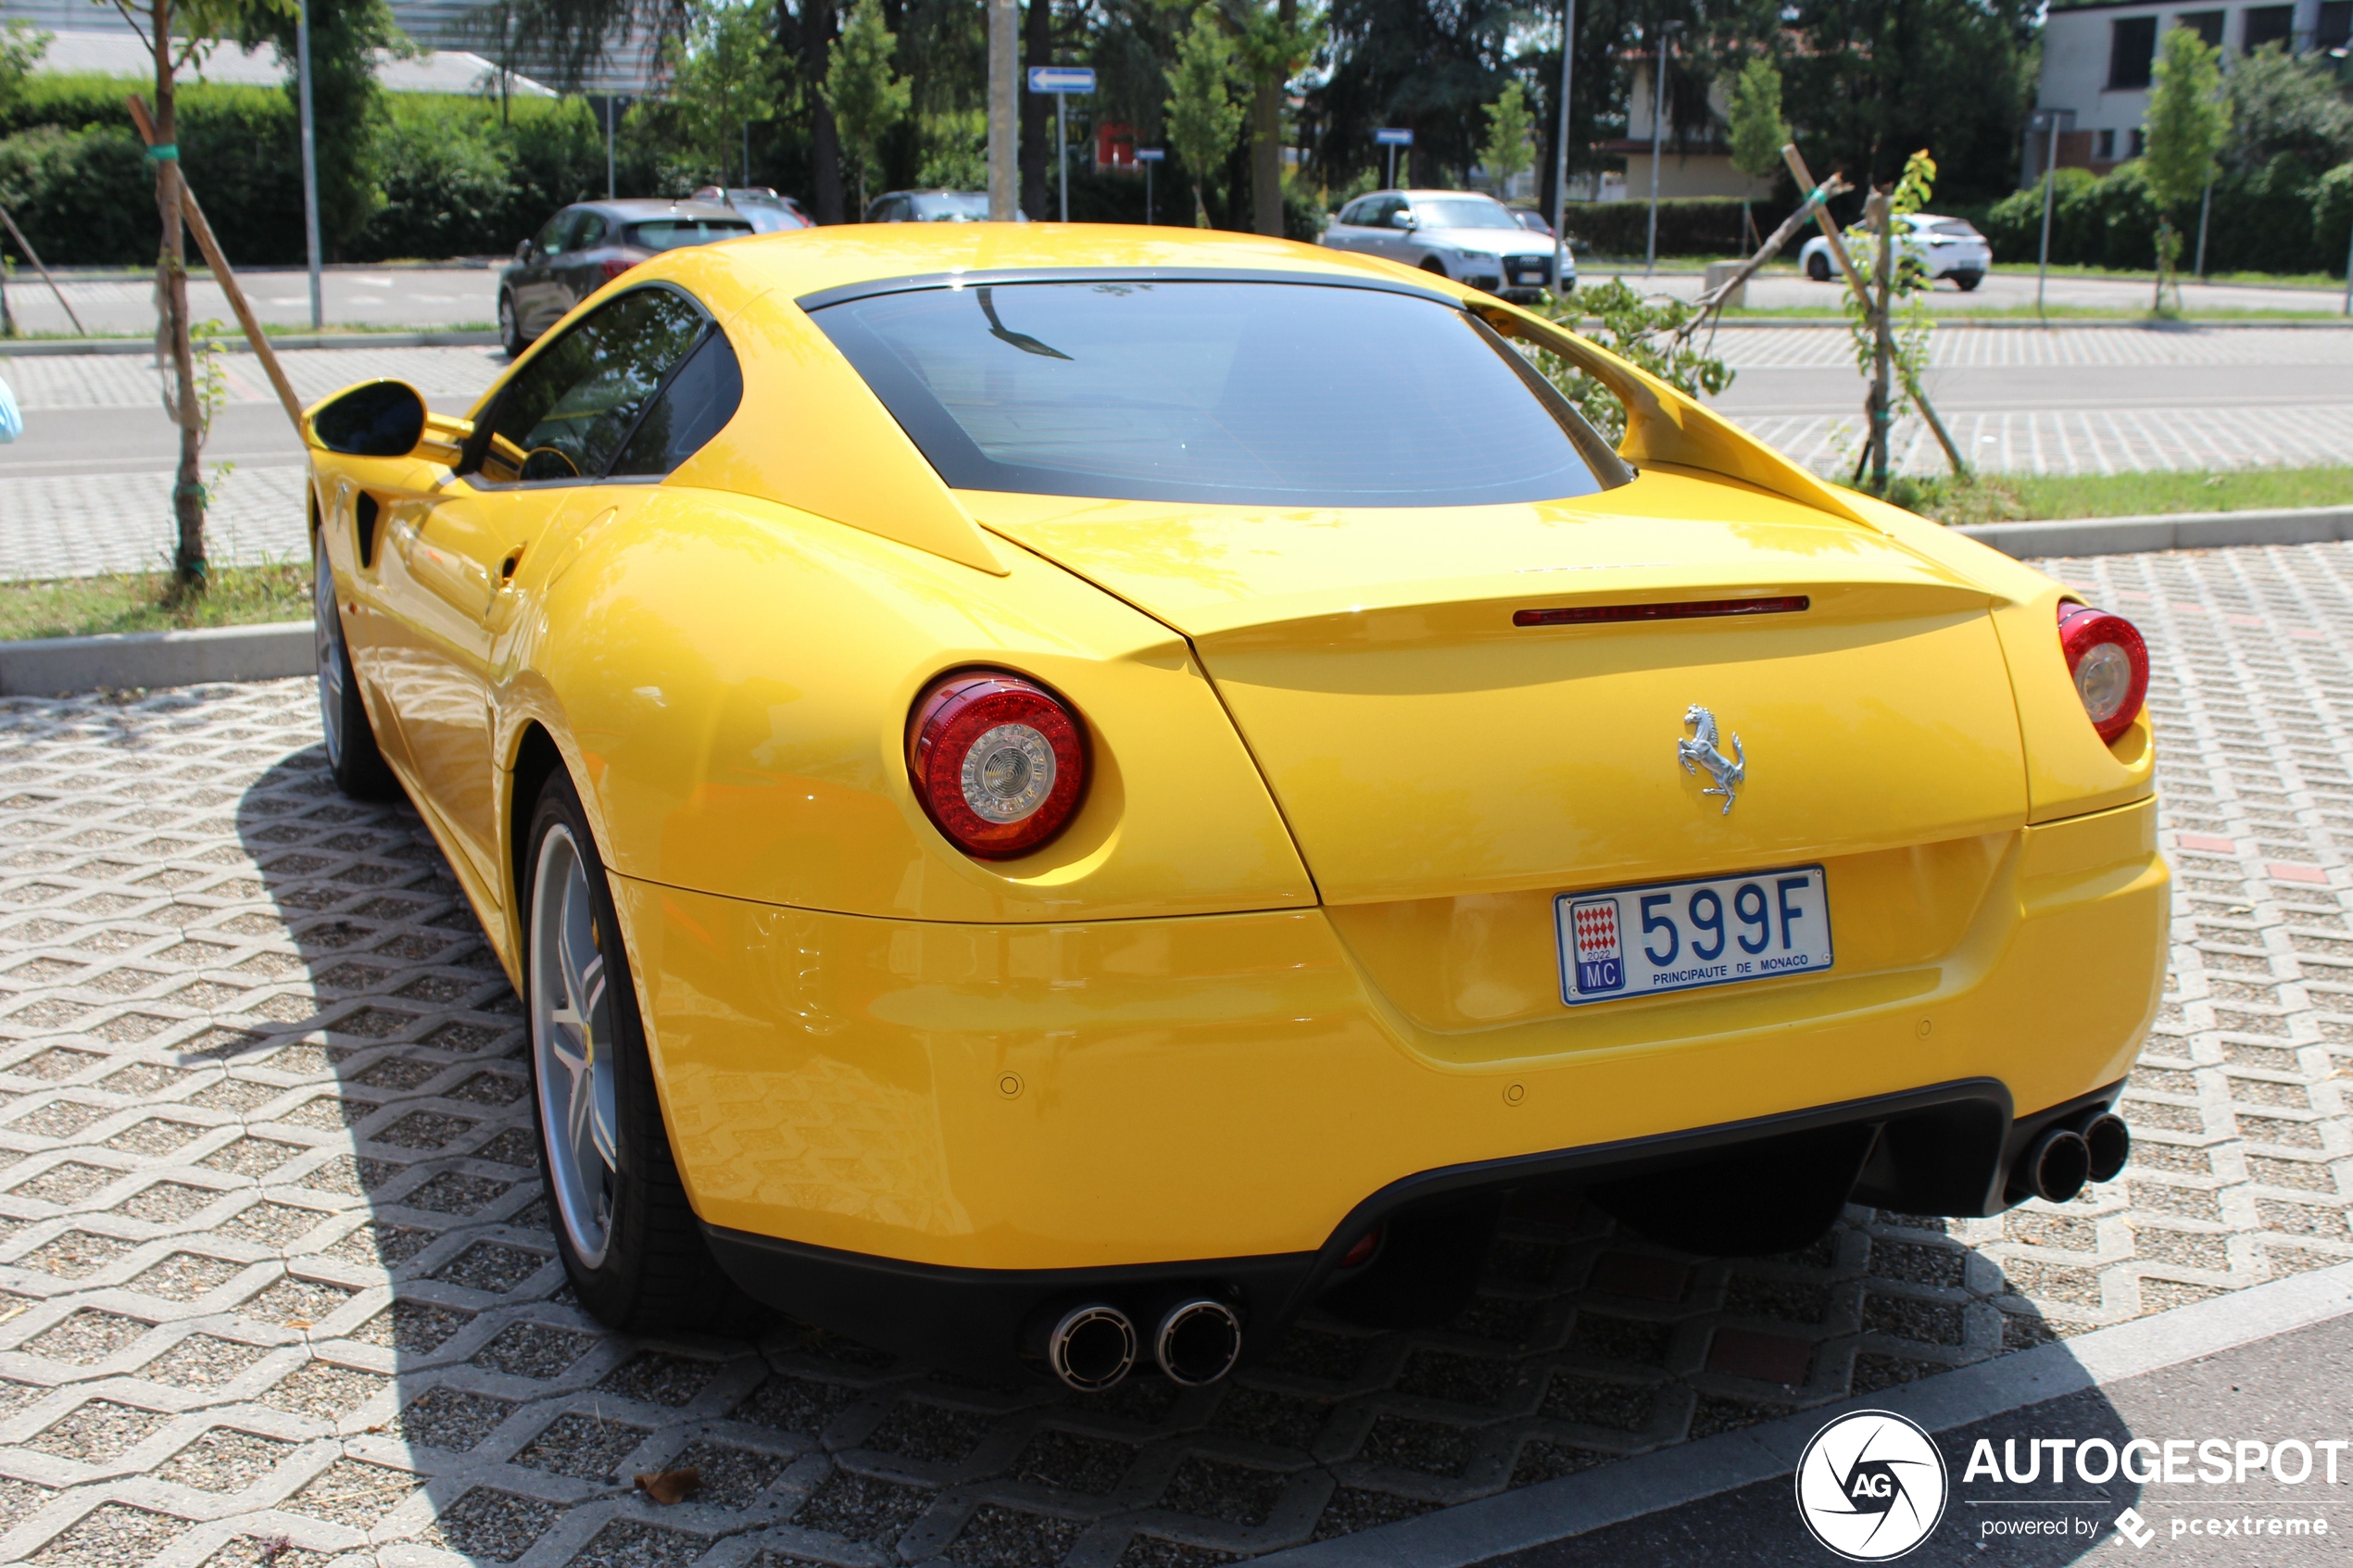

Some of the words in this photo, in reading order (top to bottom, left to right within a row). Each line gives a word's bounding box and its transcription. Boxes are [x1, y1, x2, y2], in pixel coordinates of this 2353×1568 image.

[1640, 877, 1809, 966] 599F
[1587, 949, 1611, 961] 2022
[1586, 962, 1616, 988] MC
[1653, 965, 1728, 985] PRINCIPAUTE
[1736, 961, 1752, 973] DE
[1760, 954, 1808, 971] MONACO
